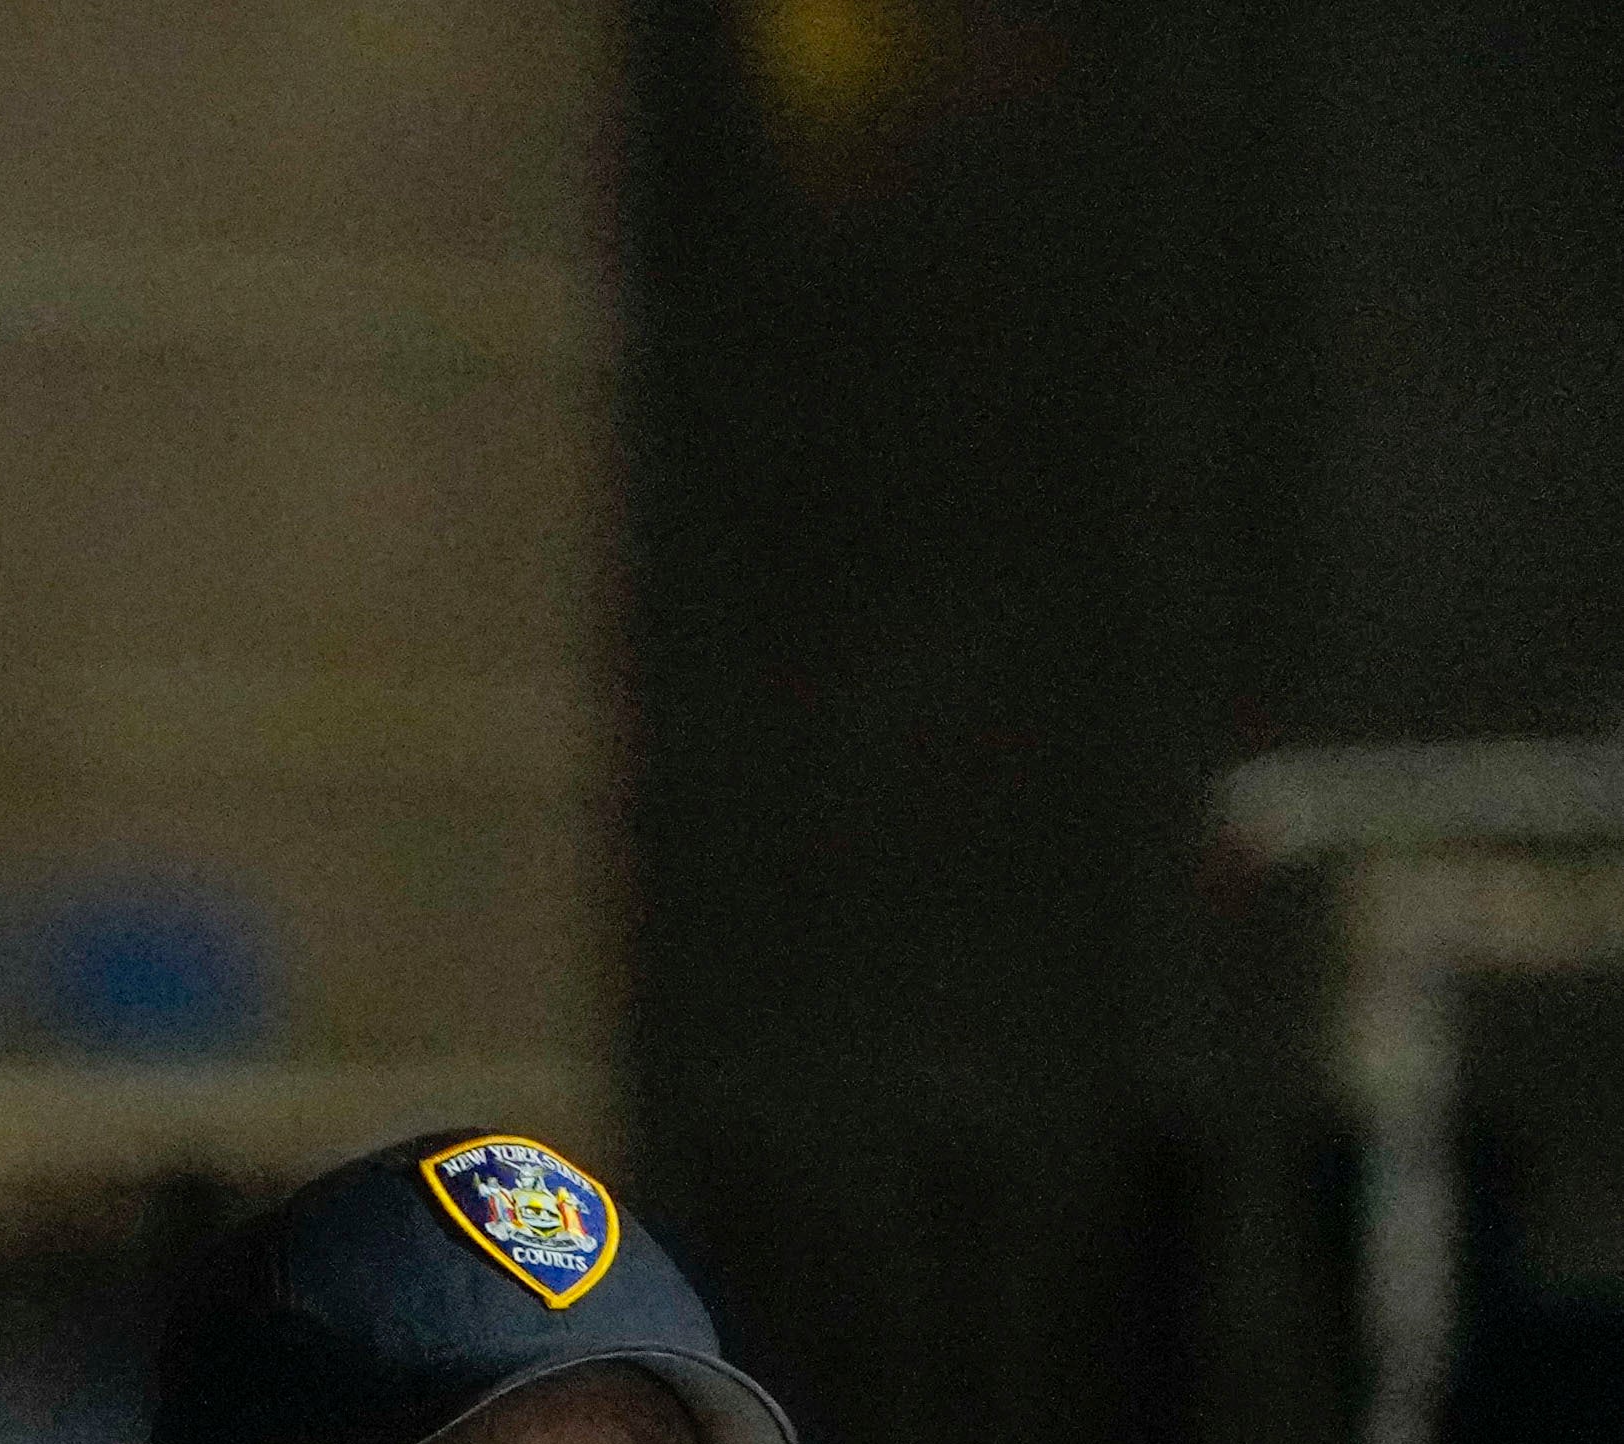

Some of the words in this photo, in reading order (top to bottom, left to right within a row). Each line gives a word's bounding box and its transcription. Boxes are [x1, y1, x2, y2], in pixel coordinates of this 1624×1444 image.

[442, 1146, 487, 1177] NEW
[488, 1145, 543, 1164] YORK
[540, 1153, 599, 1197] STATE
[513, 1246, 589, 1272] COURTS
